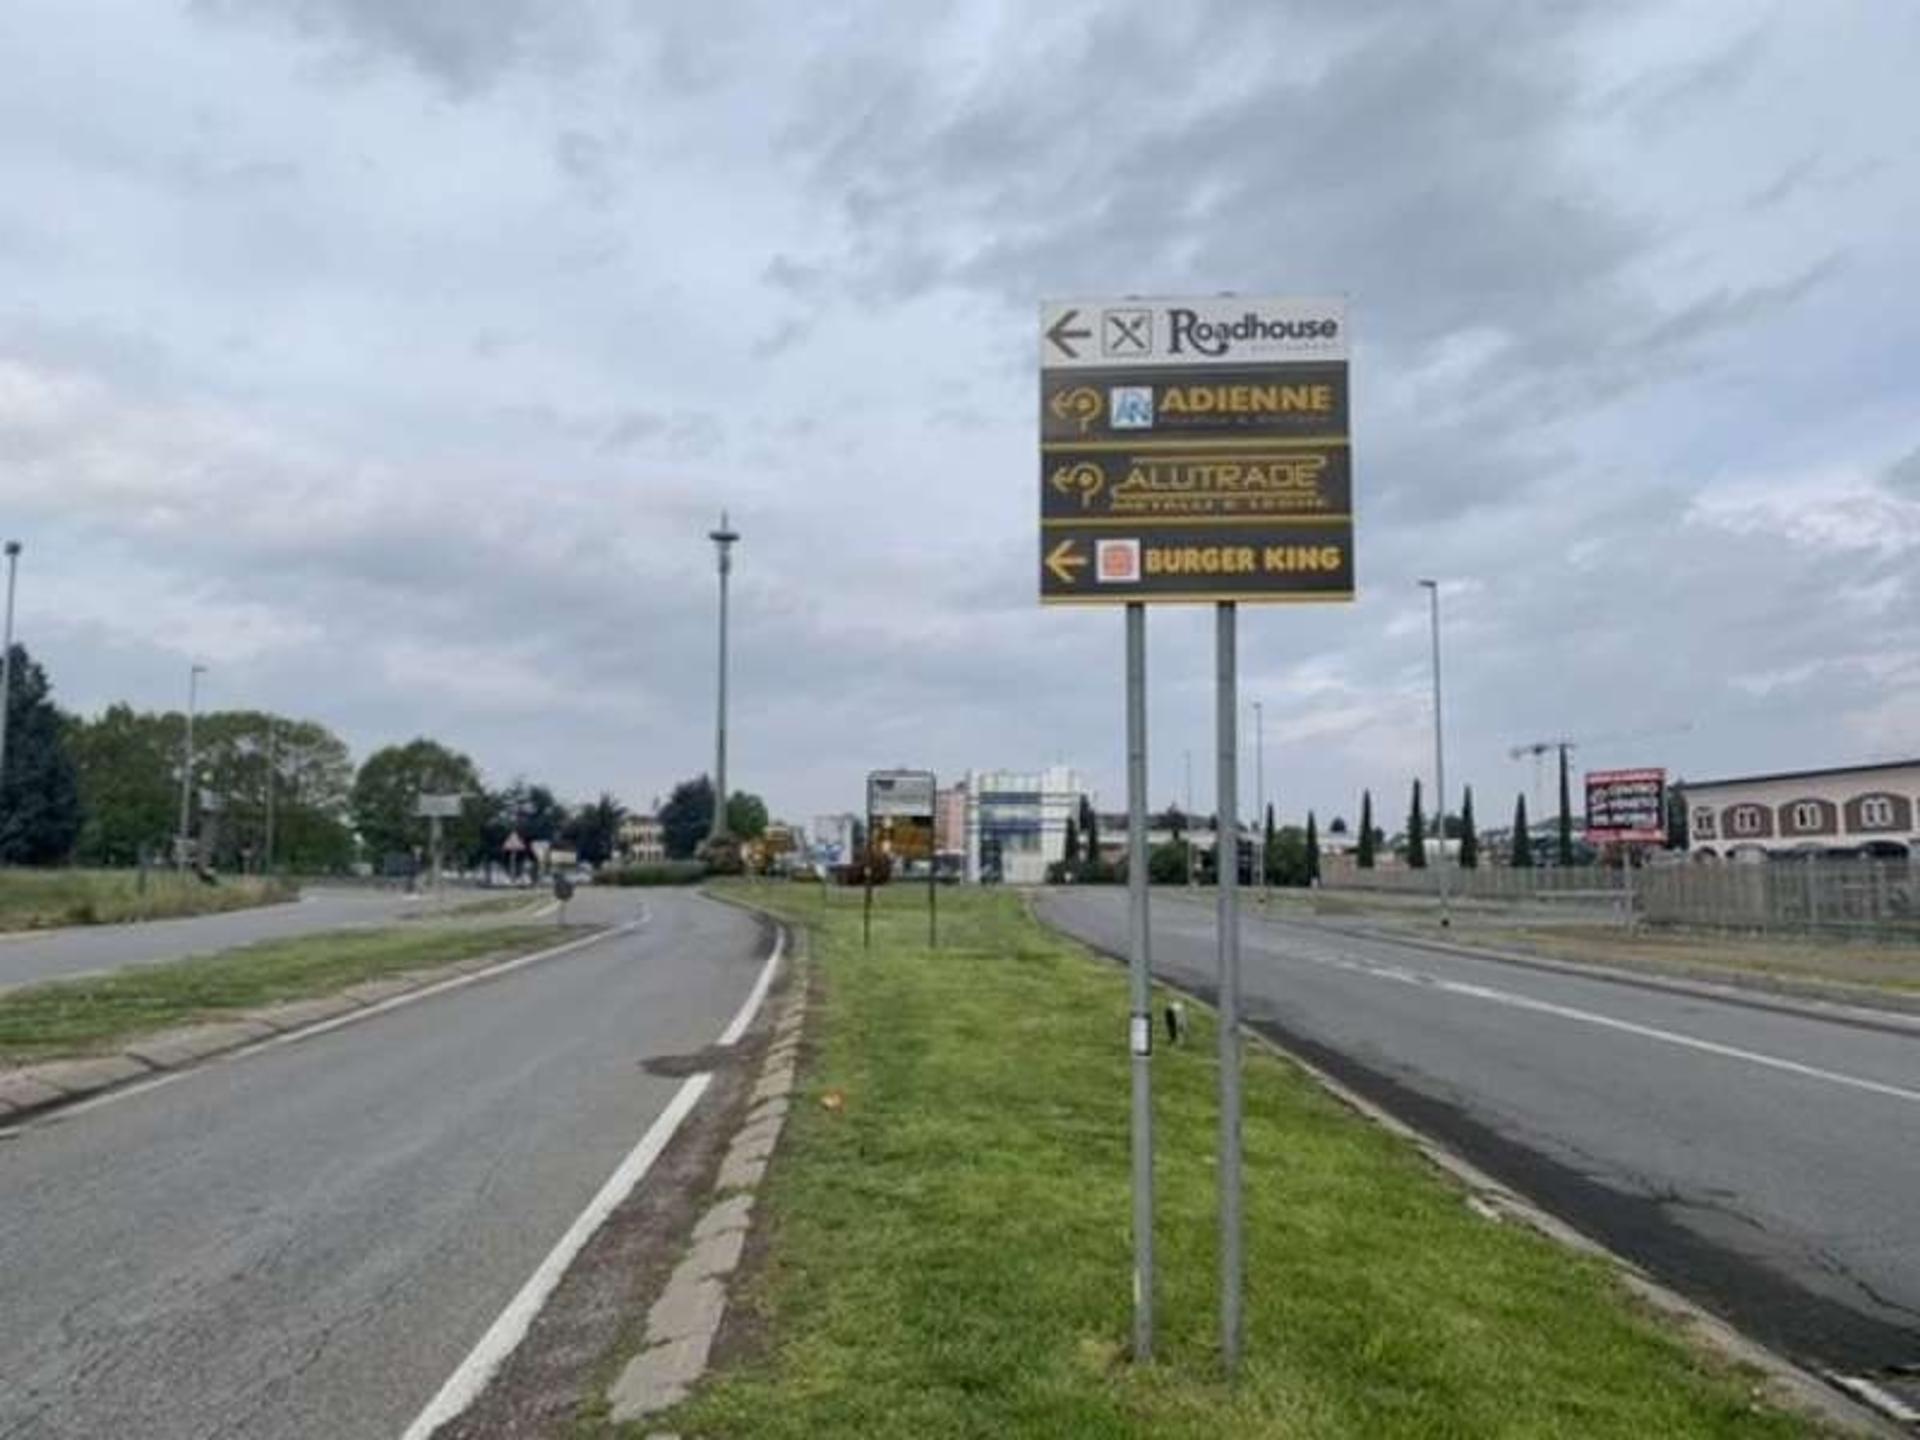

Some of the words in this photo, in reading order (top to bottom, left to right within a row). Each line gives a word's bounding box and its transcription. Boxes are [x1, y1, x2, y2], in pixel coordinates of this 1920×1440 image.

[1167, 309, 1338, 356] Roadhouse
[1158, 386, 1331, 412] ADIENNE
[1120, 466, 1318, 491] ALUTRADE
[1145, 547, 1255, 573] BURGER
[1264, 546, 1341, 571] KING
